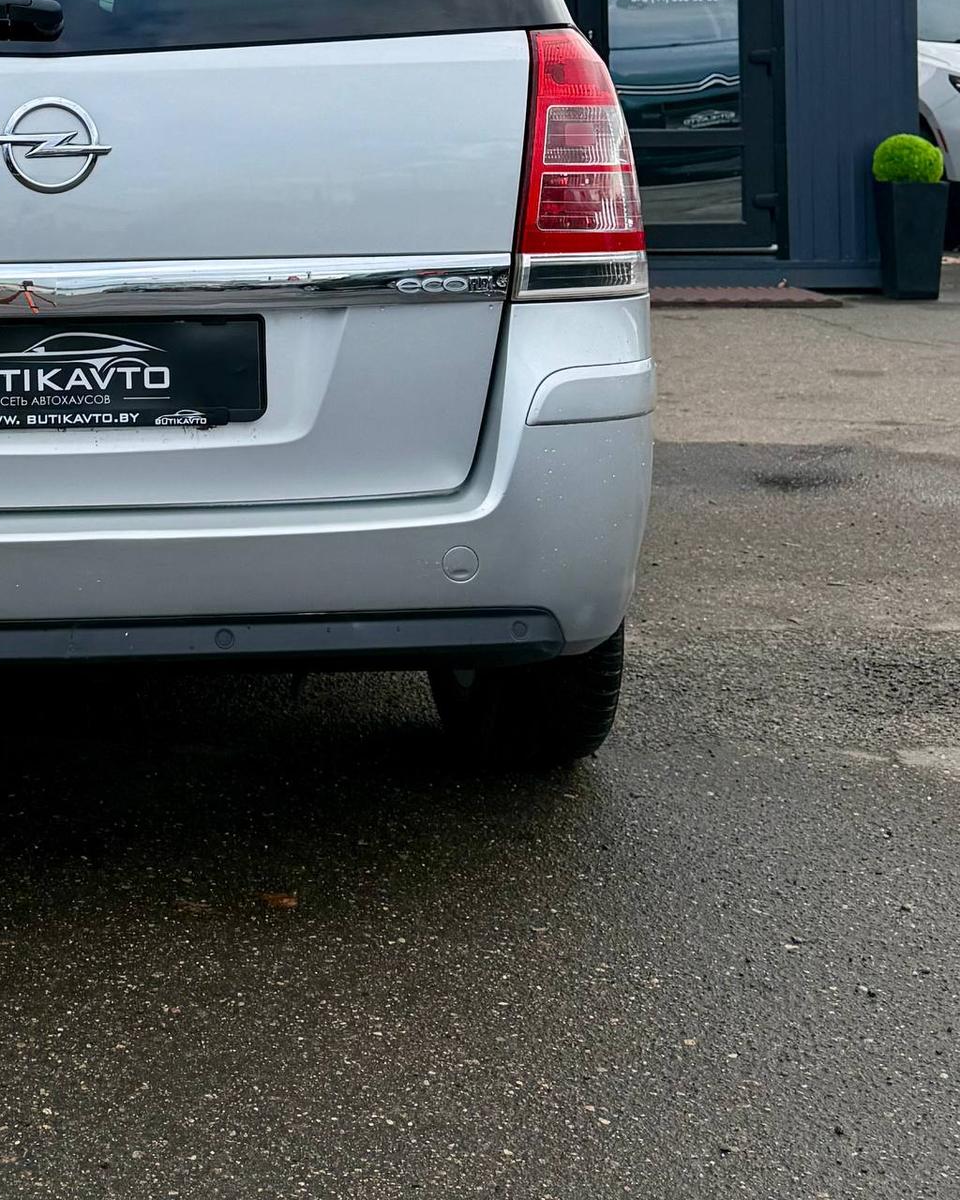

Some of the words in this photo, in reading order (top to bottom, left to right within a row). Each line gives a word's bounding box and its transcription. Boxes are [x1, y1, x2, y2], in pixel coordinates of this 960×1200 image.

[0, 396, 28, 406] СЕТЬ
[31, 394, 111, 406] АВТОХАУСОВ
[26, 413, 140, 425] BUTIKAVTO.BY
[154, 417, 207, 425] BUTIKAVTO
